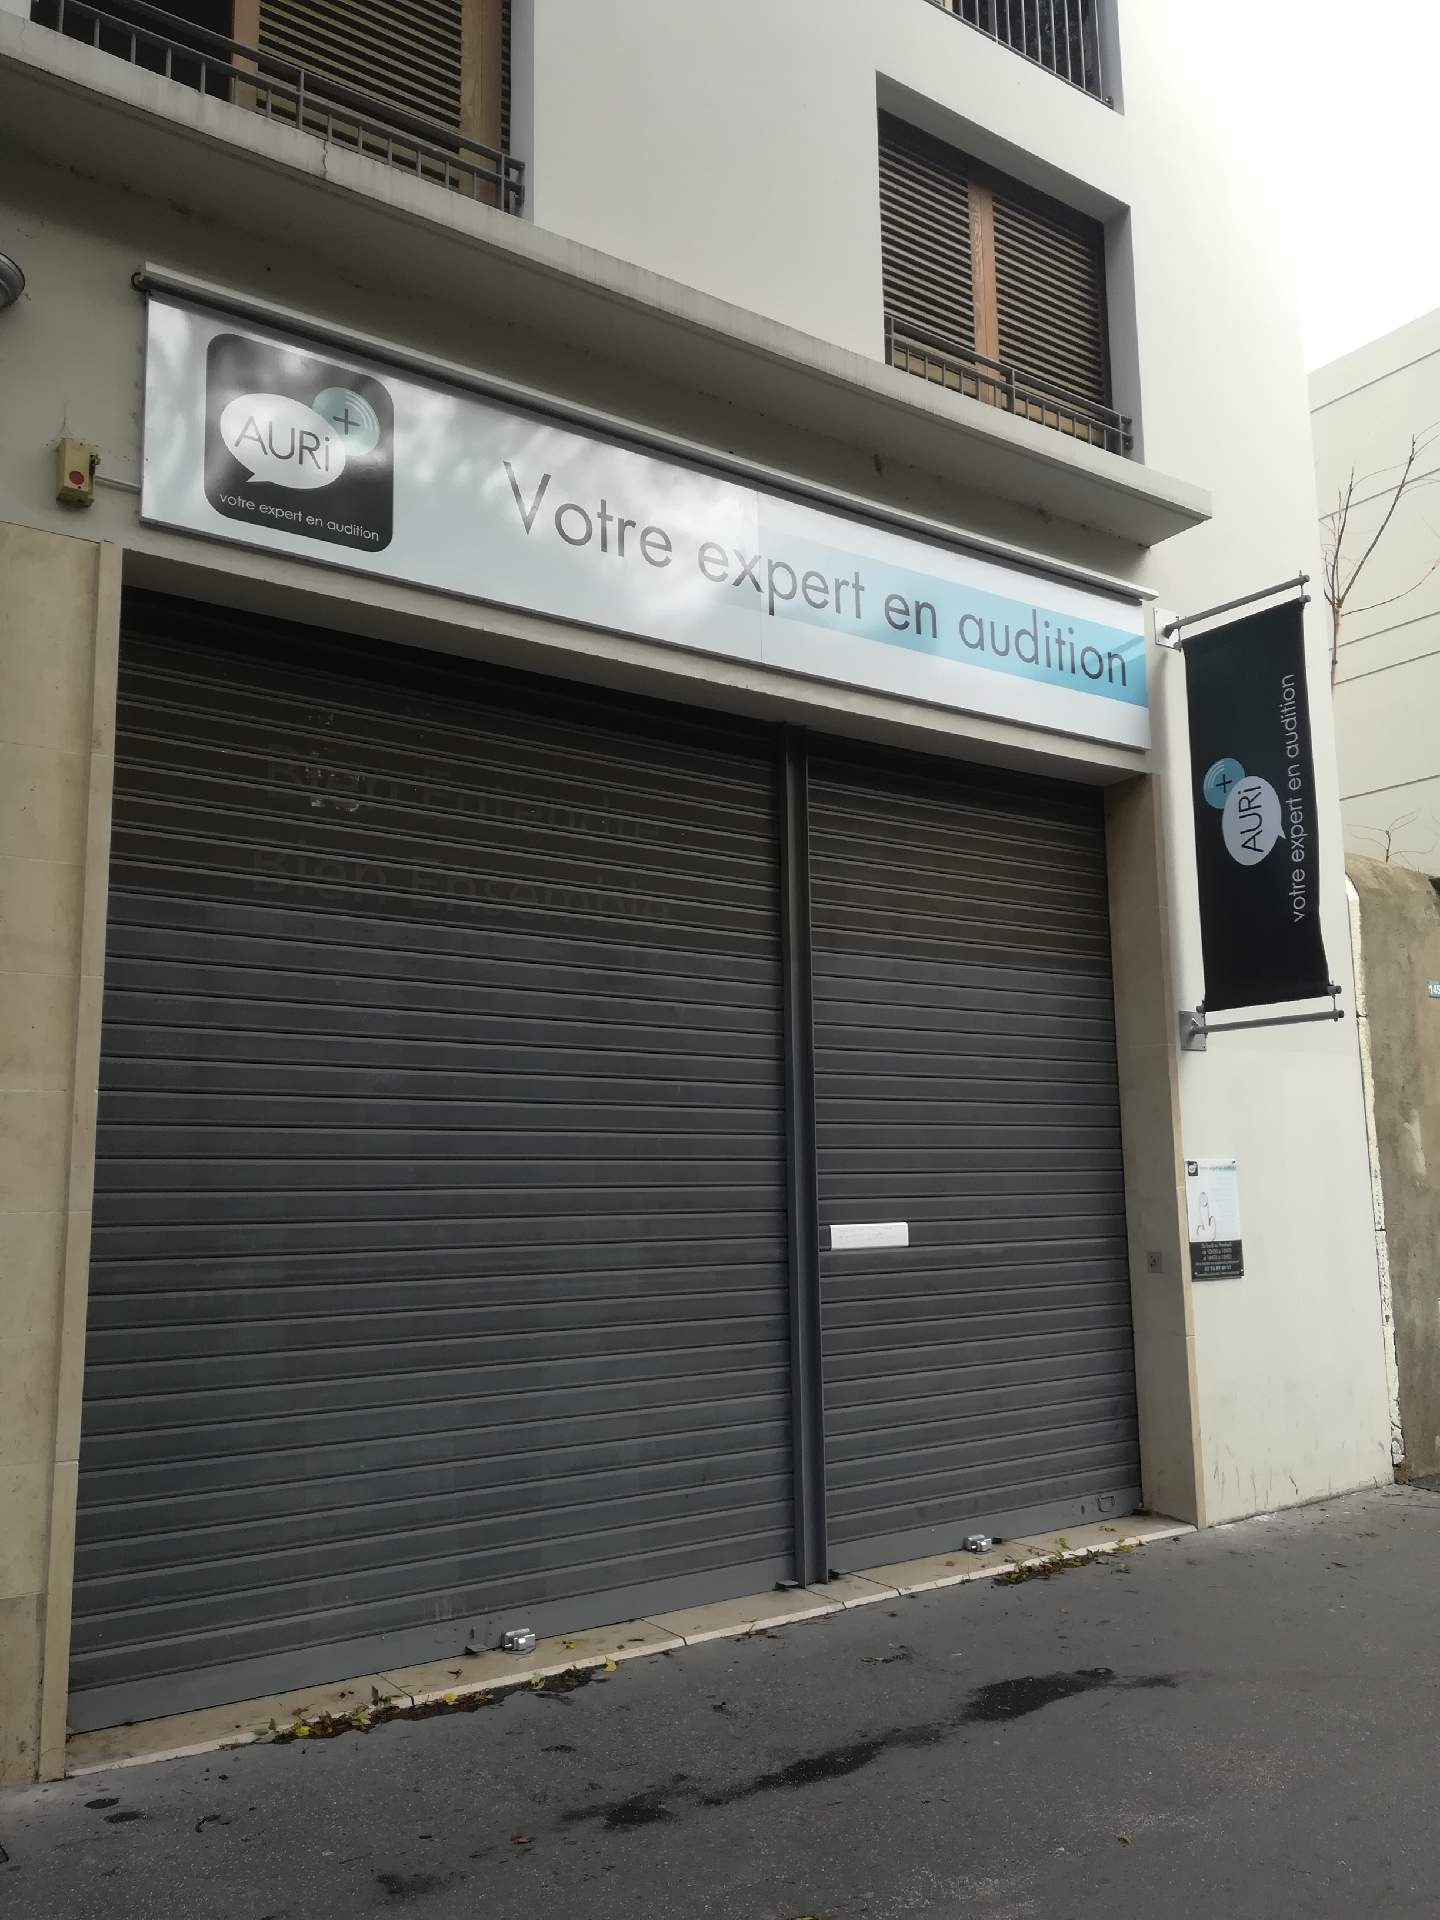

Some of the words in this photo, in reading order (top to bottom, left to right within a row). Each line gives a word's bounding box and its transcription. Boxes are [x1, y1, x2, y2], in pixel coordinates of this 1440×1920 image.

[219, 493, 256, 512] votre
[259, 501, 302, 524] expert
[305, 513, 323, 528] en
[327, 519, 380, 541] audition
[503, 460, 672, 568] Votre
[697, 540, 865, 619] expert
[884, 593, 938, 639] en
[958, 608, 1127, 687] audition
[1280, 674, 1299, 759] audition
[1288, 763, 1301, 792] en
[1286, 796, 1308, 865] expert
[251, 838, 388, 906] Bien
[1289, 869, 1306, 923] votre
